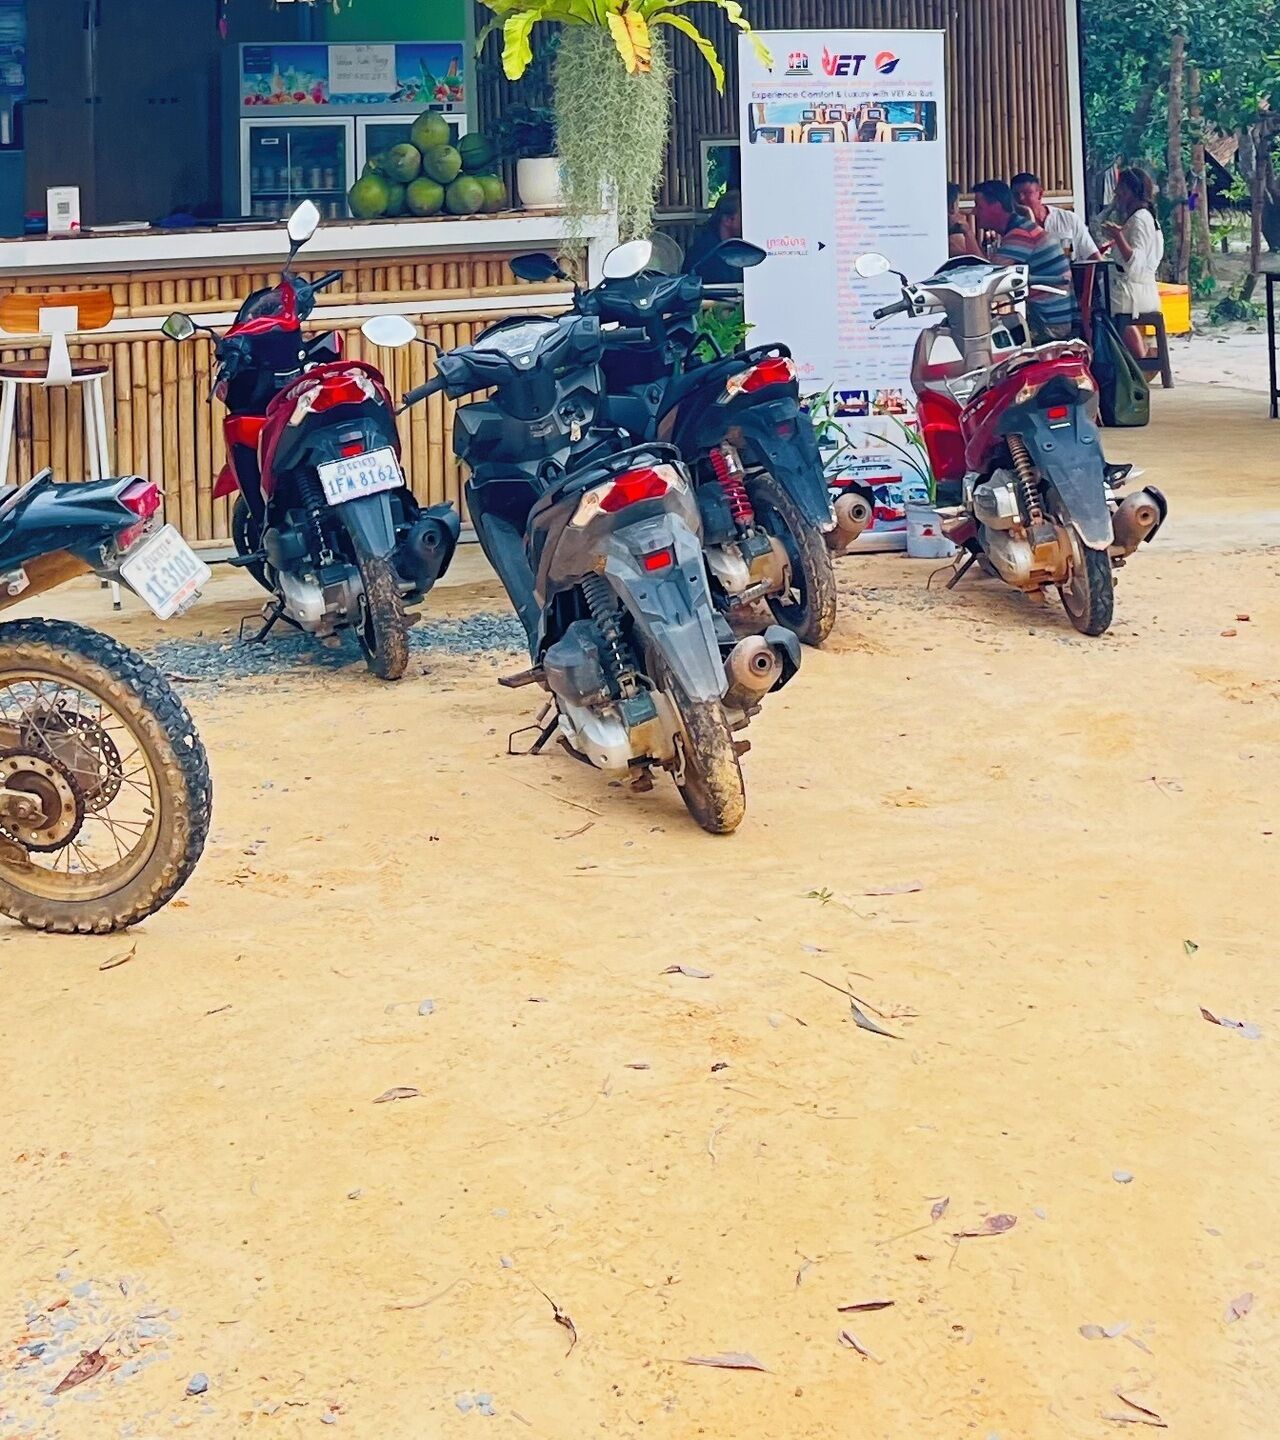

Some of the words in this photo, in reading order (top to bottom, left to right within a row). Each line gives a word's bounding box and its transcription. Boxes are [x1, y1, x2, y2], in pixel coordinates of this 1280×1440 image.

[821, 46, 866, 76] VET
[752, 90, 798, 100] Experience
[800, 89, 834, 99] Comfort
